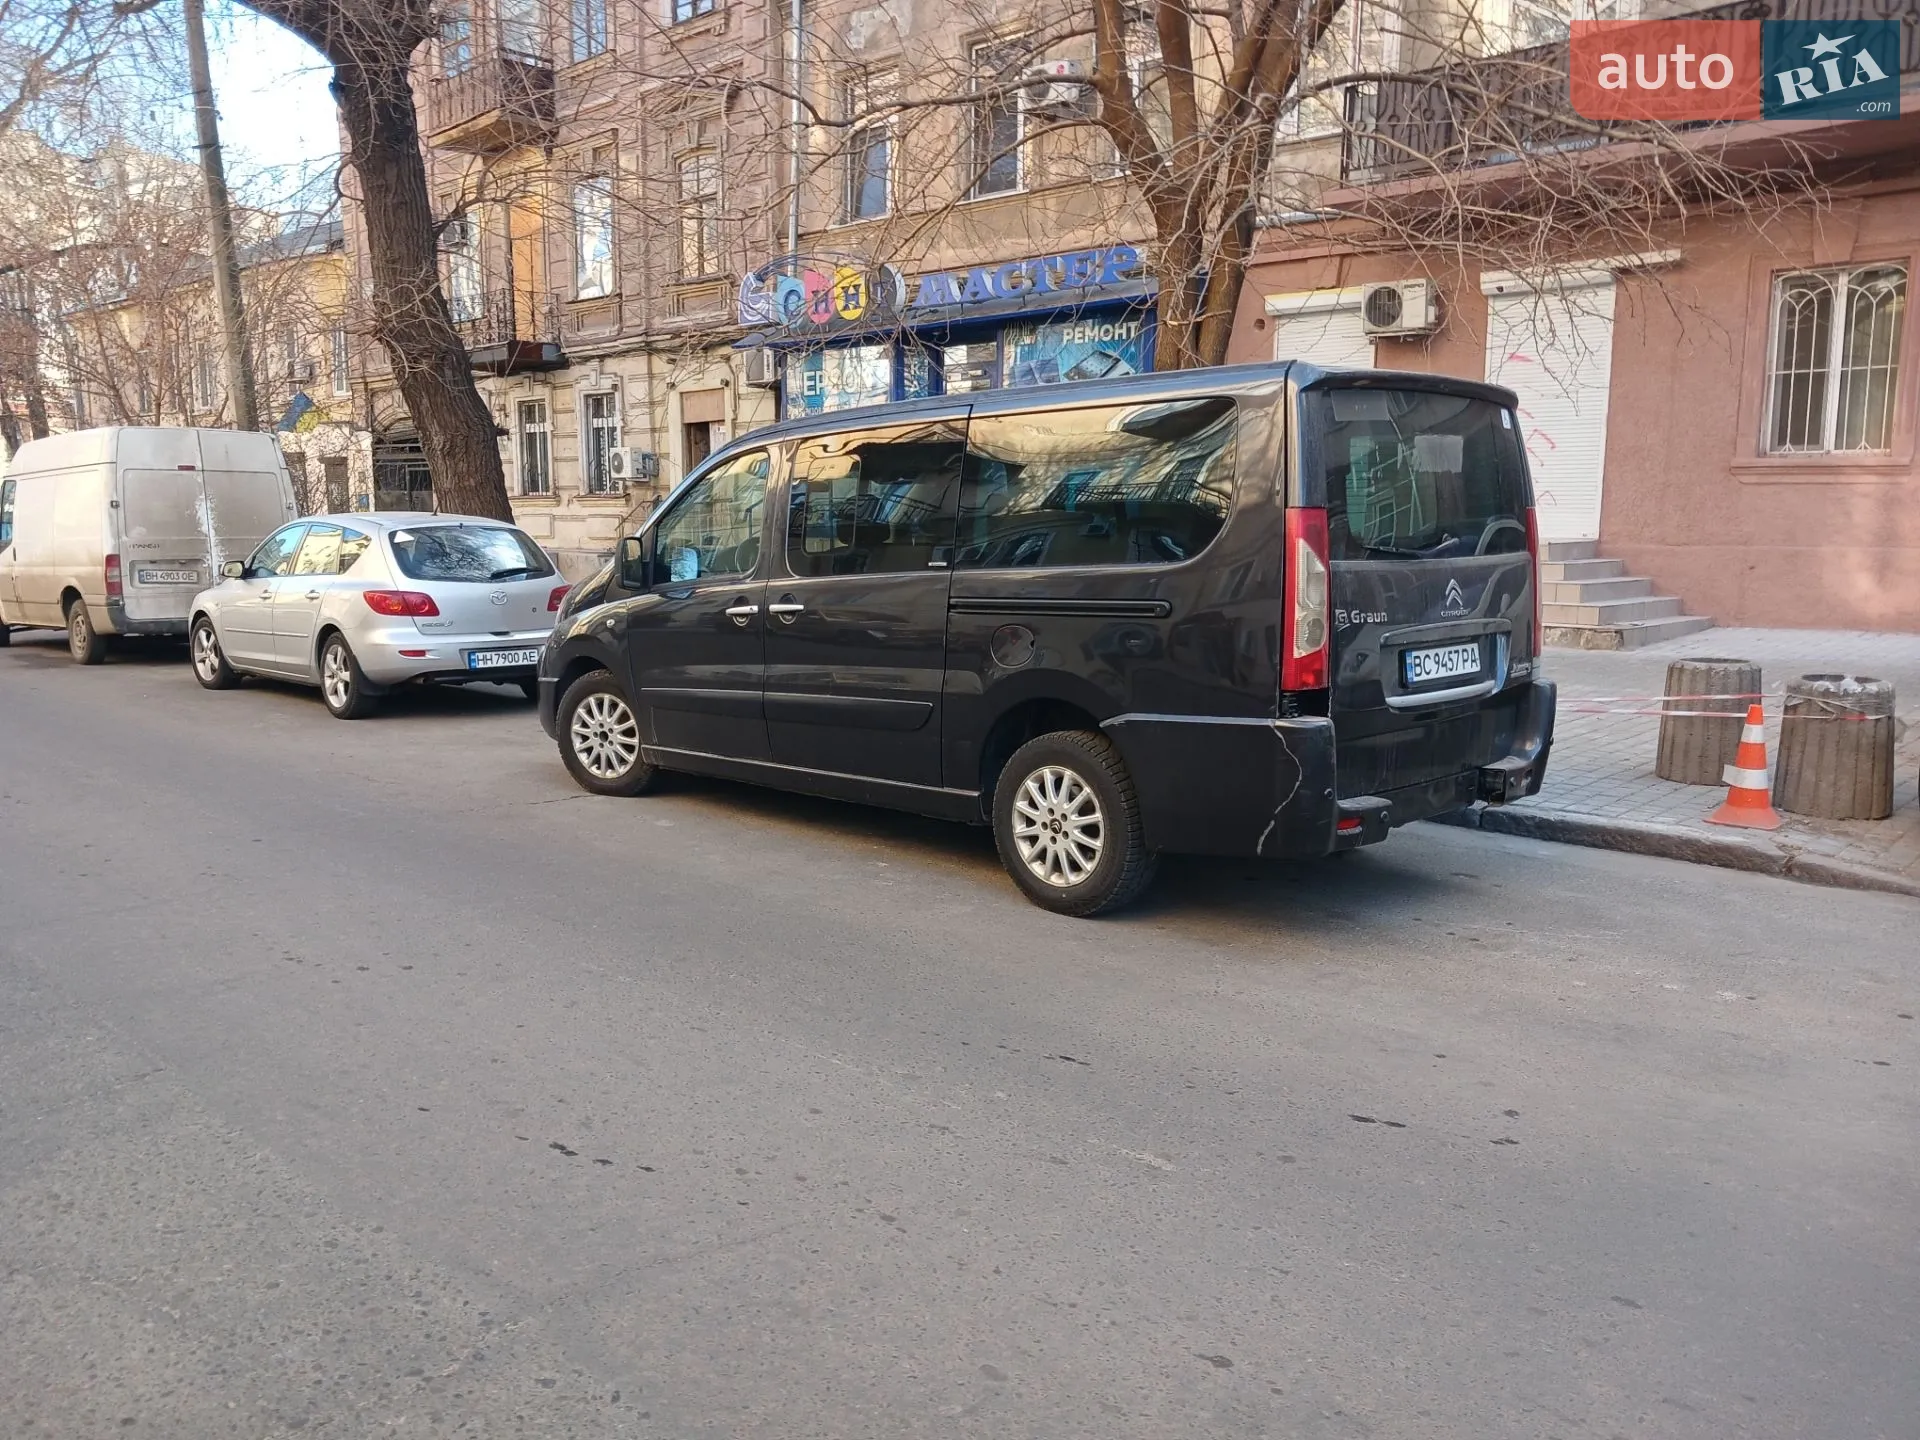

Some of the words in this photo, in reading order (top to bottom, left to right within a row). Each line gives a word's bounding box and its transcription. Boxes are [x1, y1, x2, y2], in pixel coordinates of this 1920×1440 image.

[912, 245, 1143, 307] МАСТЕР
[1063, 320, 1139, 345] РЕМОНТ
[1350, 609, 1388, 624] Graun
[476, 653, 494, 667] HH
[495, 652, 520, 665] 7900
[521, 651, 537, 664] AE
[1413, 653, 1433, 677] BC
[1434, 649, 1460, 674] 9457
[1462, 646, 1479, 669] PA
